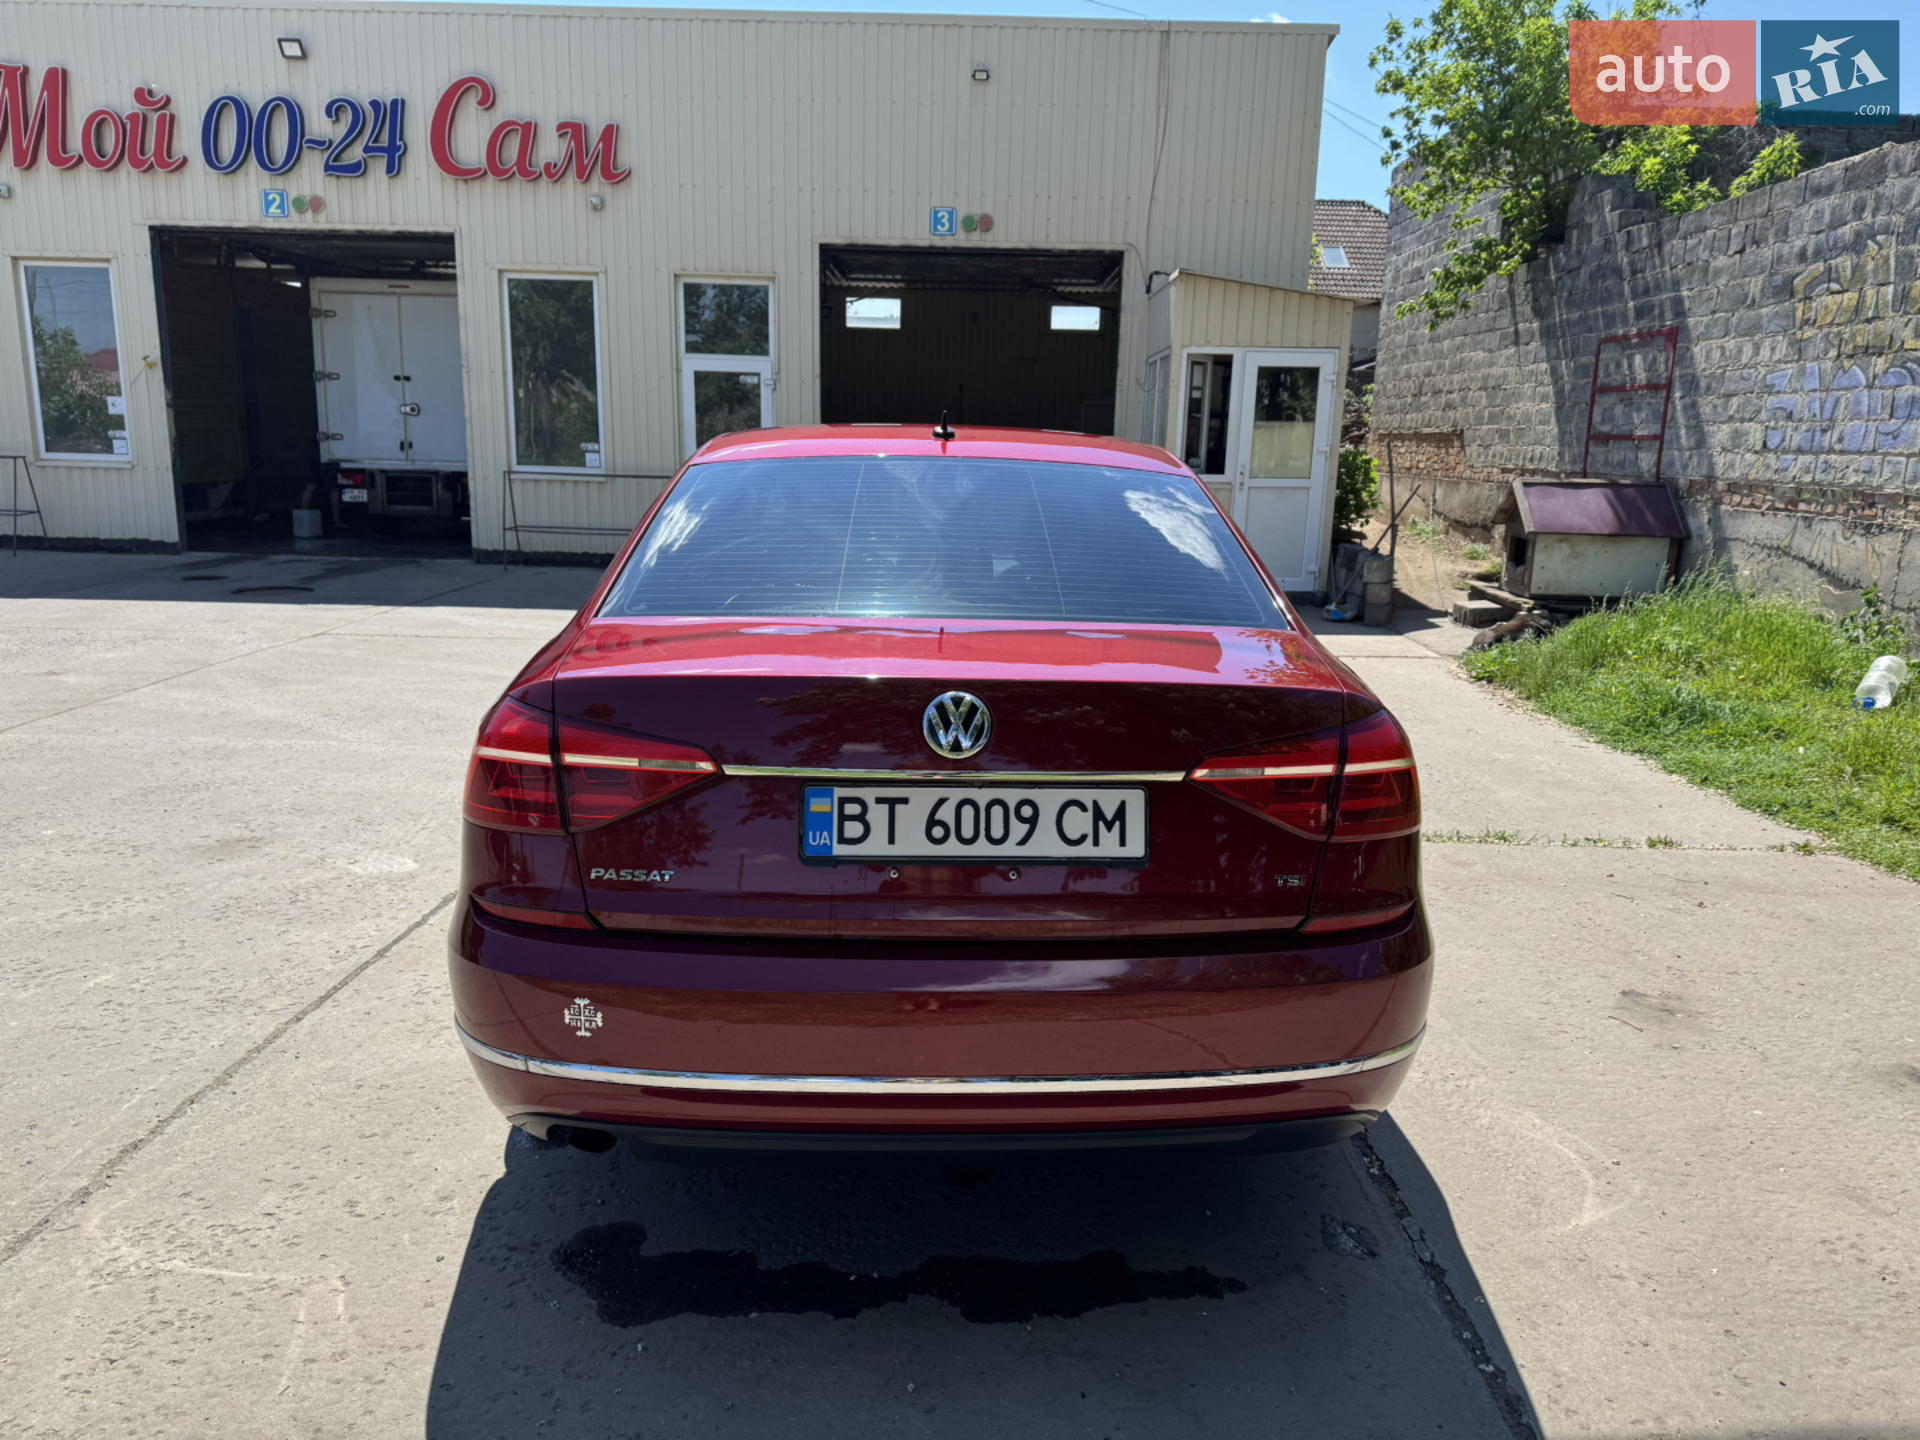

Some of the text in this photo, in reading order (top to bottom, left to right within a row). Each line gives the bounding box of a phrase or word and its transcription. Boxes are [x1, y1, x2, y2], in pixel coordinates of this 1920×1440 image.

[0, 63, 631, 184] Мой 00-24 Сам
[268, 193, 283, 214] 2
[937, 211, 950, 232] 3
[837, 796, 1127, 848] BT 6009 CM
[809, 830, 832, 847] UA
[590, 868, 675, 882] PASSAT
[1274, 874, 1307, 888] TSI
